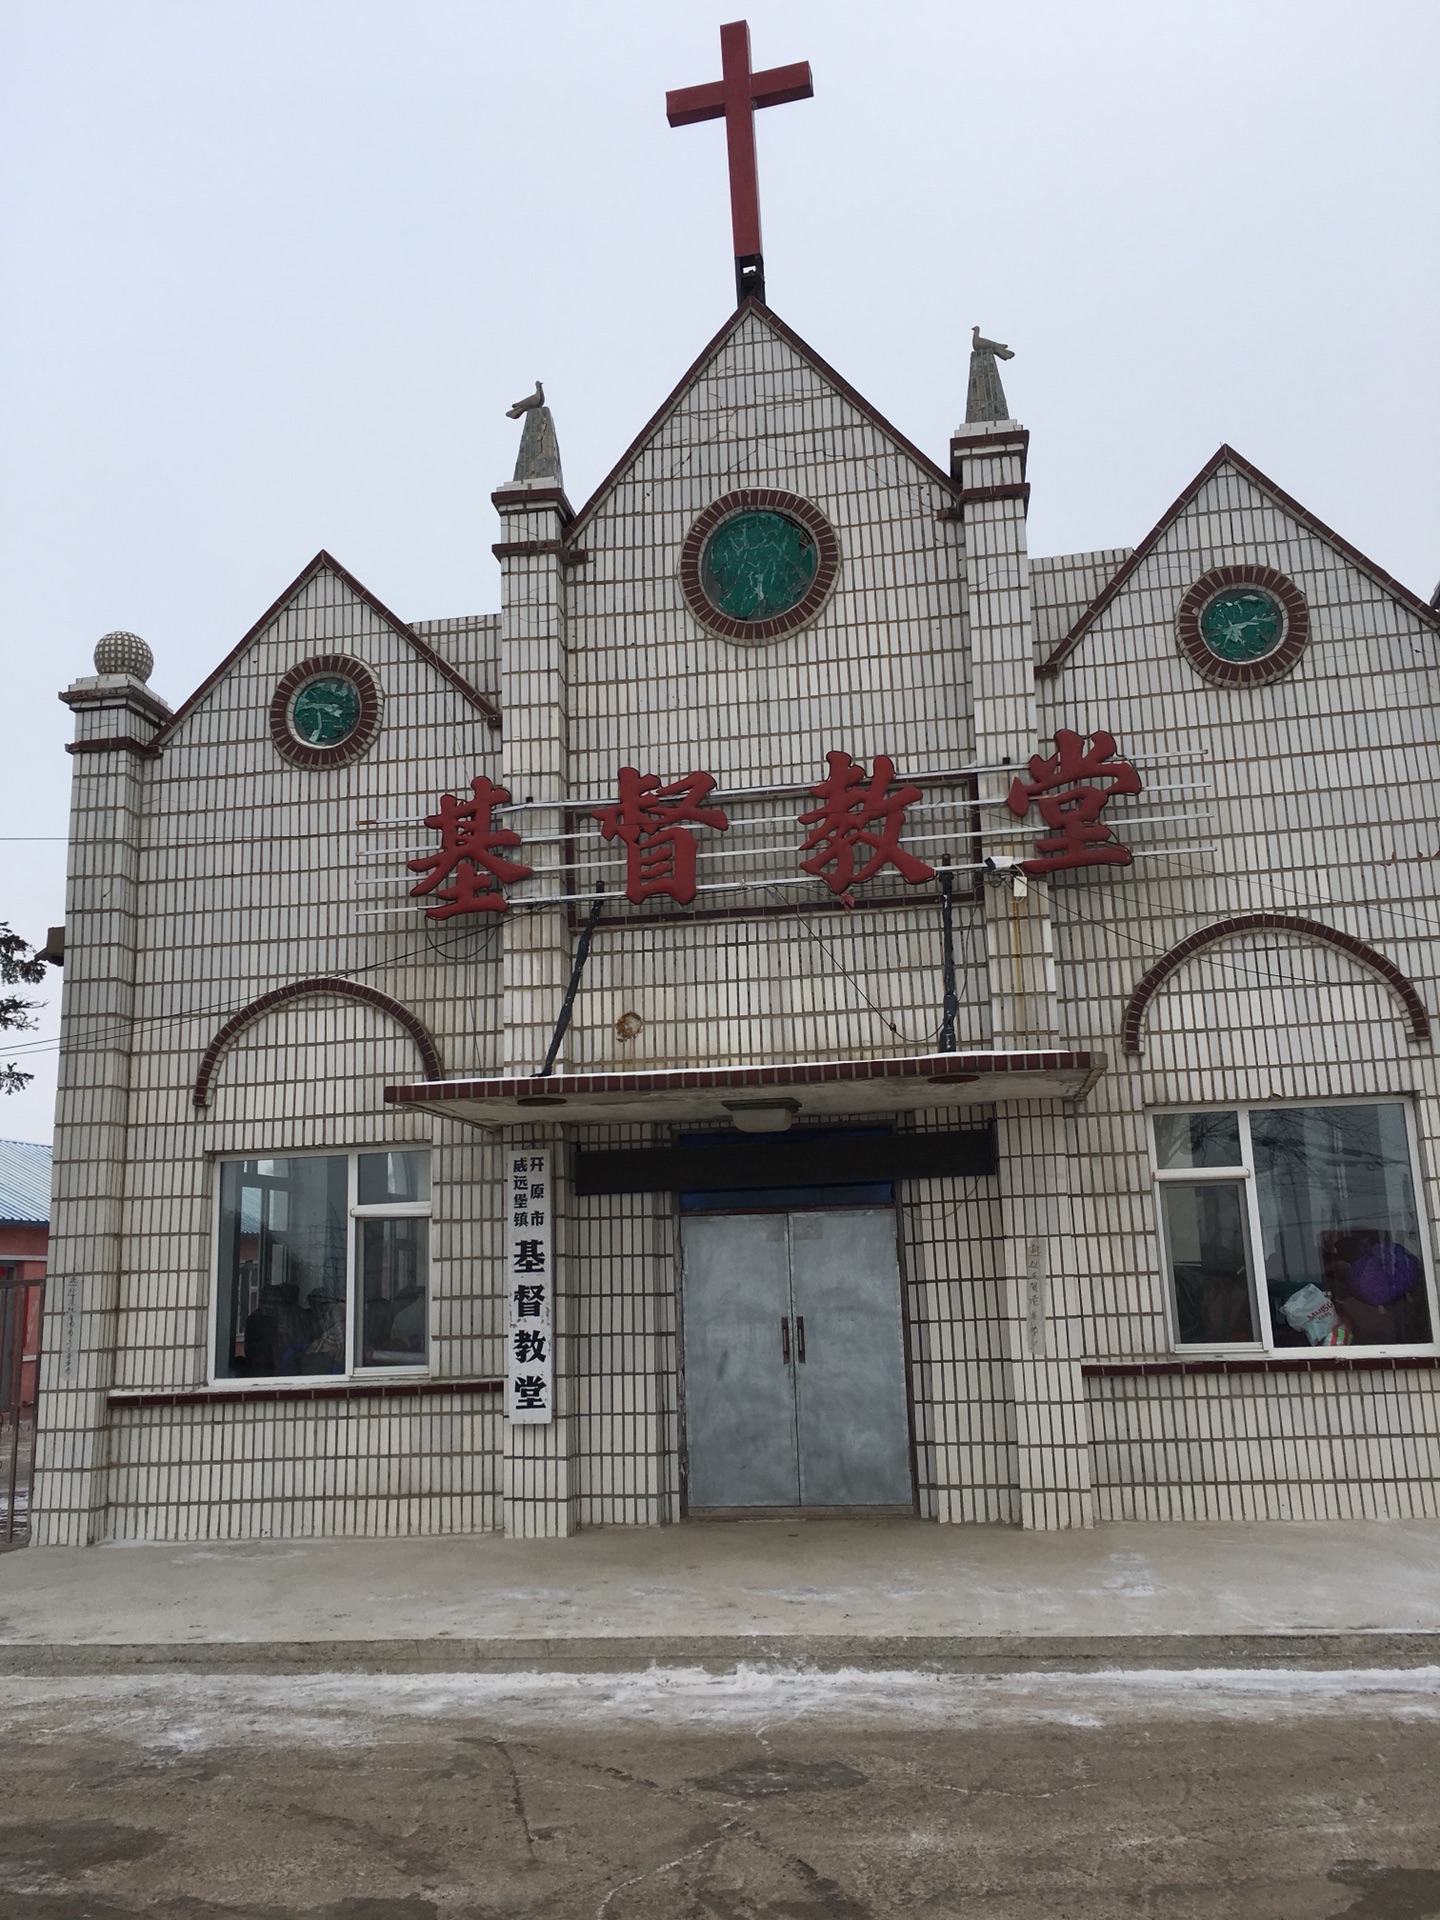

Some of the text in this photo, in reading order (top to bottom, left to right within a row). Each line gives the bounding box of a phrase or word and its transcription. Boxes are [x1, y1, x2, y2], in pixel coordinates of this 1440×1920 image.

[407, 728, 1142, 920] 基督教堂
[513, 1157, 529, 1227] 威远堡镇
[530, 1156, 544, 1226] 开原市
[513, 1239, 547, 1410] 基督教堂
